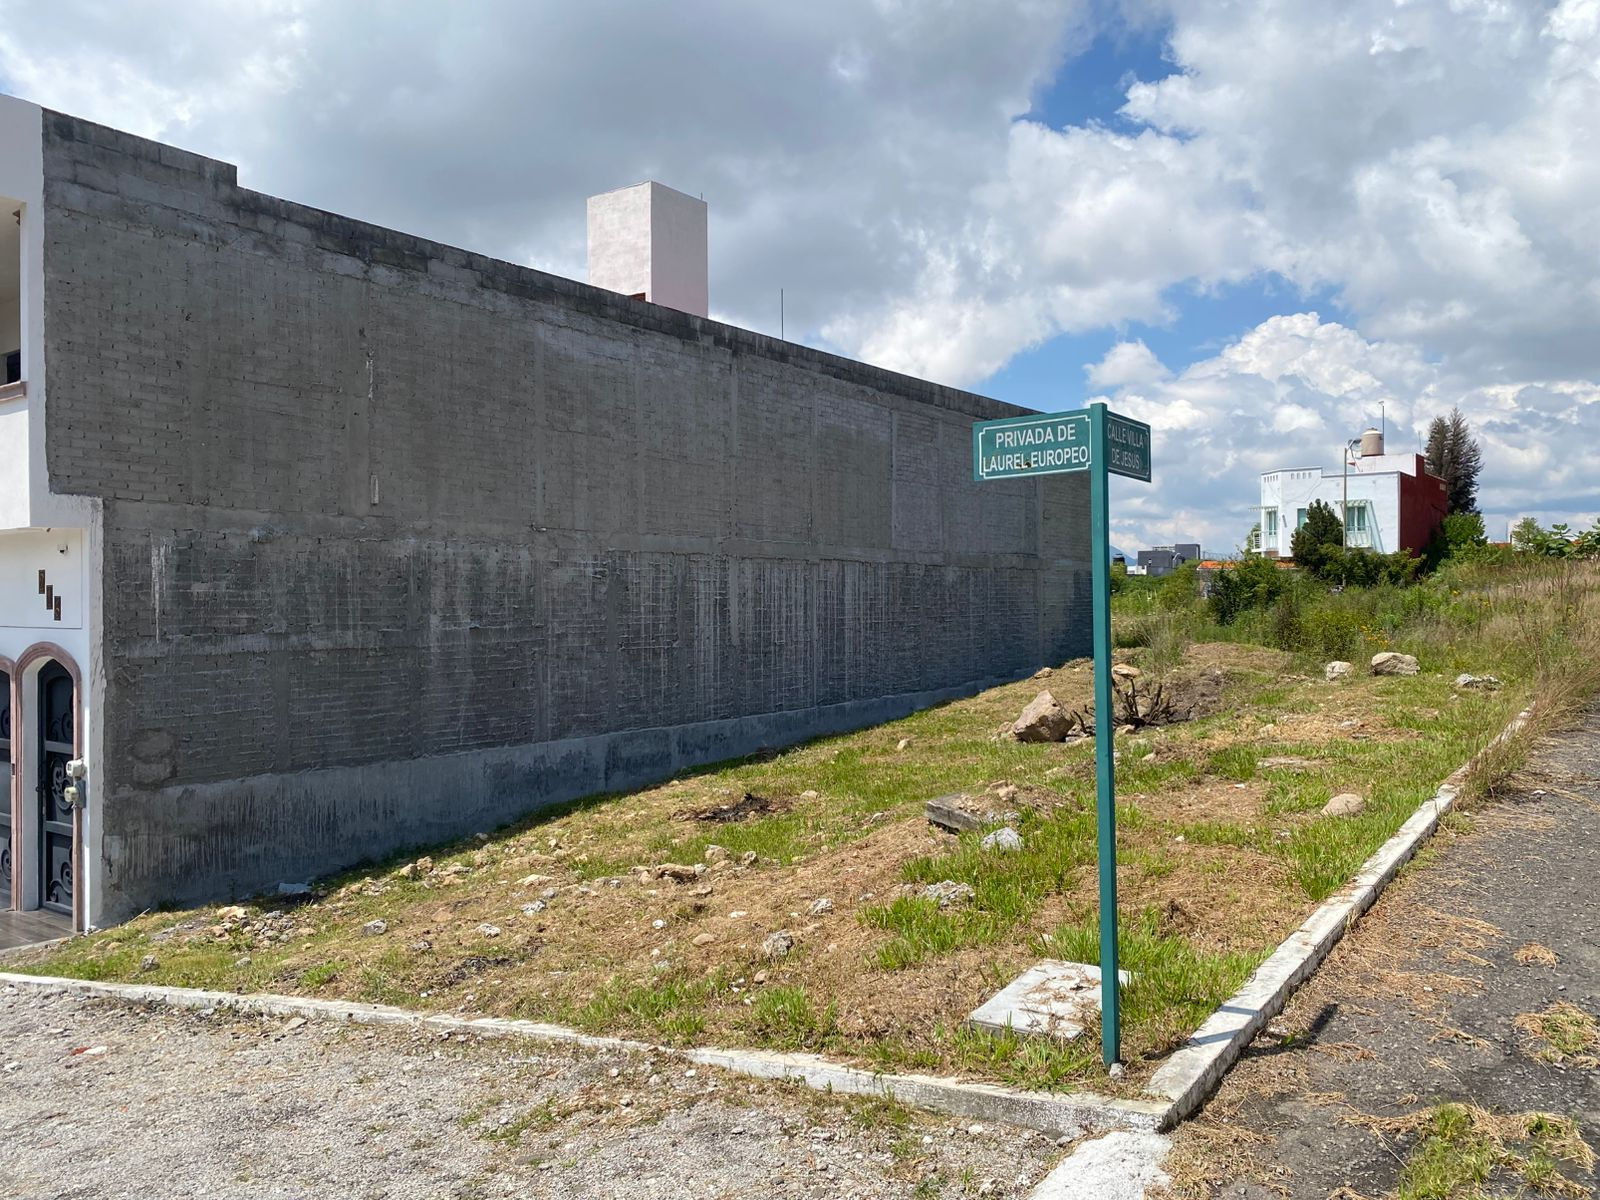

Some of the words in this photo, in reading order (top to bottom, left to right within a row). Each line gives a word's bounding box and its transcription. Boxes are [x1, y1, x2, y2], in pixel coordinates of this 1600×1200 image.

[995, 428, 1054, 449] PRIVADA
[1057, 424, 1076, 442] DE
[1107, 423, 1127, 443] CALLE
[1127, 429, 1144, 448] VILLA
[983, 454, 1028, 472] LAUREL
[1031, 446, 1088, 467] EUROPEO
[1111, 448, 1121, 464] DE
[1120, 451, 1140, 469] JESUS
